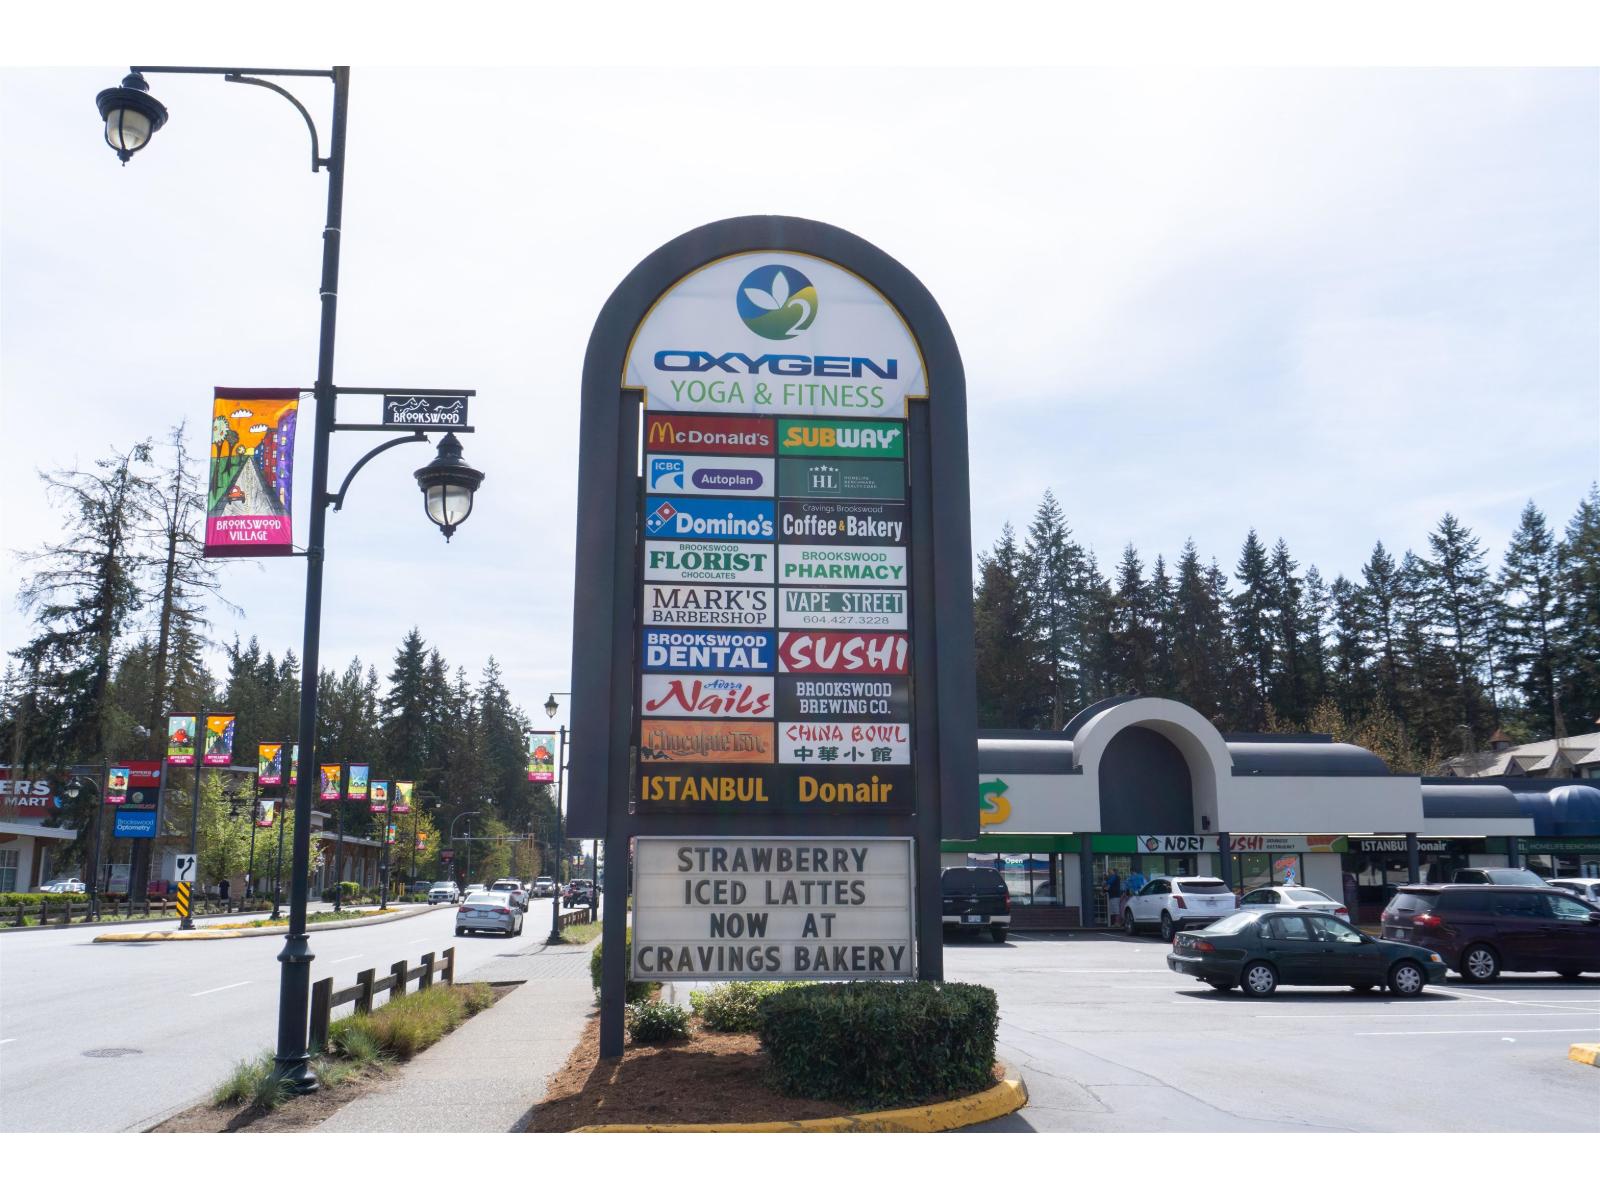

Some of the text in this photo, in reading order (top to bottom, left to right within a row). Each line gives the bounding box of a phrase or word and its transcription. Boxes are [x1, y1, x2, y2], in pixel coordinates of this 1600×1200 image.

[653, 350, 898, 380] OXYGEN
[670, 379, 885, 409] YOGA & FITNESS
[393, 411, 460, 424] BROOKSWOOD
[649, 421, 770, 446] McDonald's
[783, 426, 901, 449] SUBWAY
[655, 461, 681, 471] ICBC
[701, 474, 754, 487] Autoplan
[812, 475, 838, 489] HL
[802, 503, 884, 514] Cravings Brookswood
[216, 518, 282, 532] BROOKSWOOD
[676, 512, 774, 536] Domino's
[783, 513, 903, 542] Coffee & Bakery
[229, 530, 269, 542] VILLAGE
[680, 543, 739, 552] BROOKSWOOD
[802, 551, 888, 562] BROOKSWOOD
[649, 550, 768, 572] FLORIST
[681, 571, 736, 580] CHOCOLATES
[784, 563, 904, 580] PHARMACY
[652, 588, 768, 611] MARK'S
[788, 592, 901, 613] VAPE STREET
[652, 610, 768, 625] BARBERSHOP
[803, 615, 890, 625] 604.427.3228
[648, 633, 767, 648] BROOKSWOOD
[647, 645, 769, 669] DENTAL
[789, 635, 909, 671] SUSHI
[646, 680, 770, 715] Nails
[796, 681, 892, 698] BROOKSWOOD
[799, 699, 892, 714] BREWING CO.
[786, 725, 908, 744] CHINA BOWL
[793, 745, 893, 763] 中華小館
[642, 775, 893, 803] ISTANBUL Donair
[1165, 836, 1264, 851] NORI SHI
[677, 847, 869, 873] STRAWBERRY
[685, 879, 866, 905] ICED LATTES
[710, 912, 836, 938] NOW AT
[637, 945, 905, 972] CRAVINGS BAKERY
